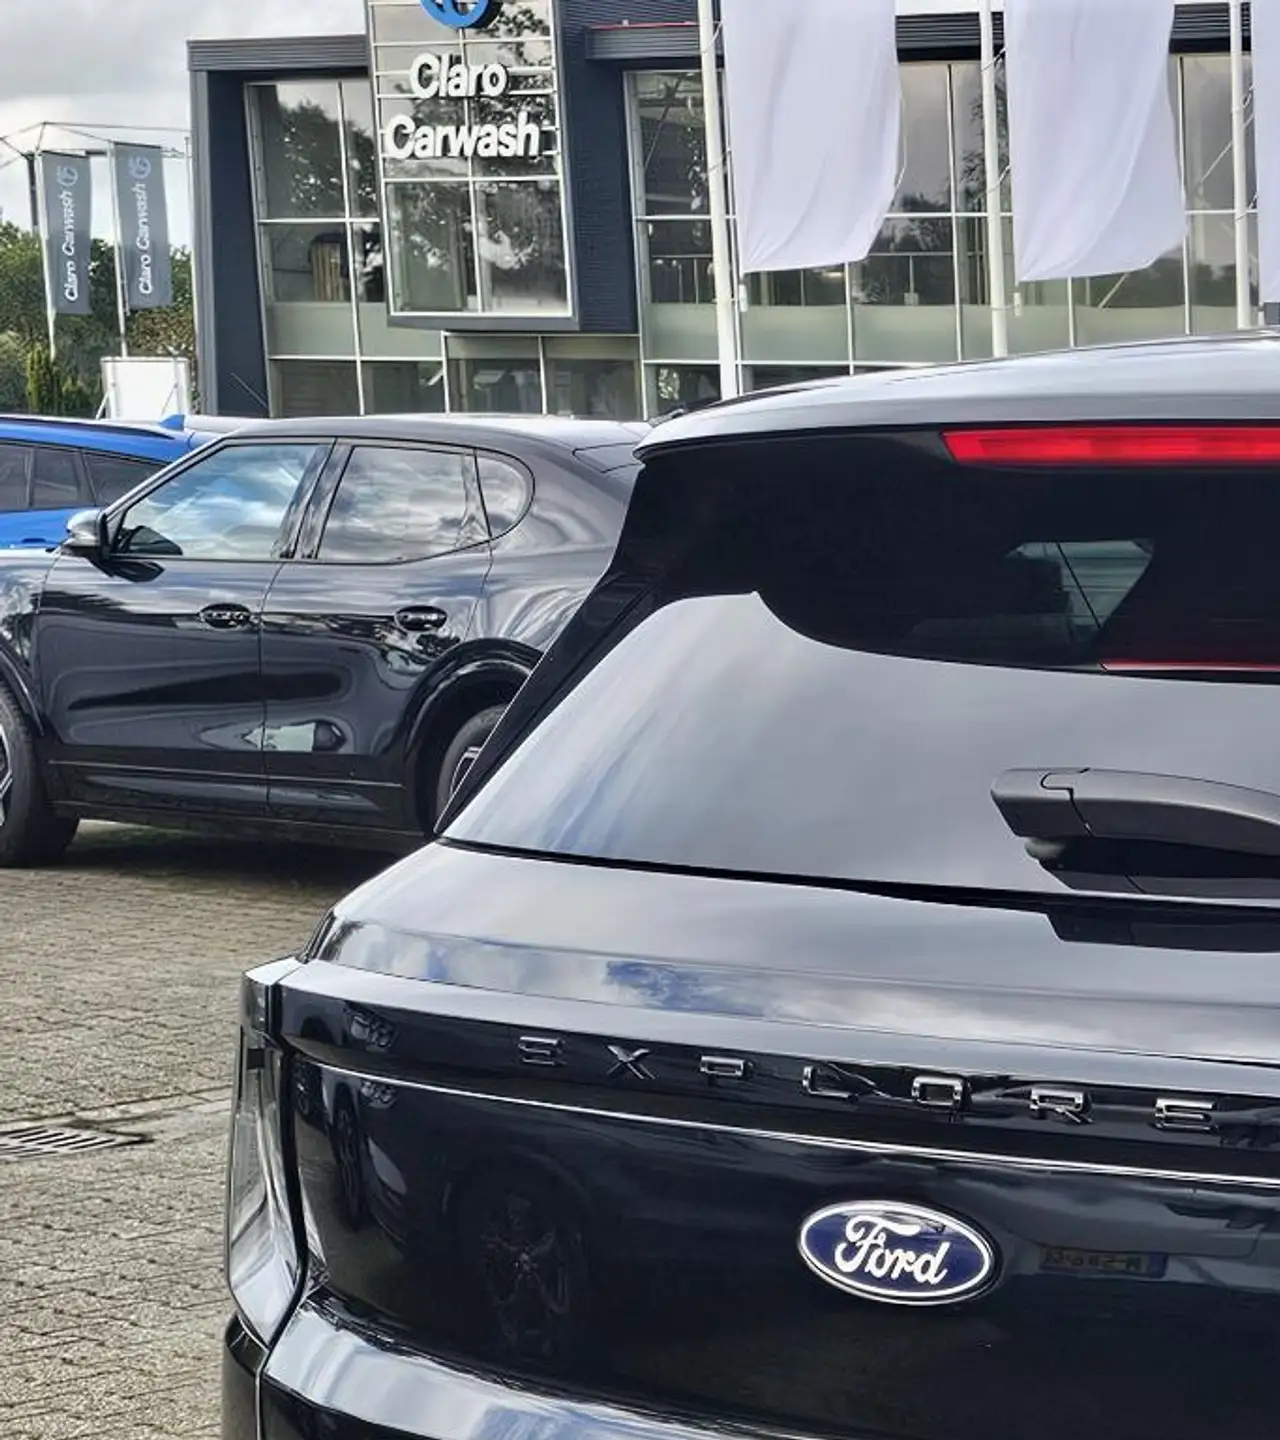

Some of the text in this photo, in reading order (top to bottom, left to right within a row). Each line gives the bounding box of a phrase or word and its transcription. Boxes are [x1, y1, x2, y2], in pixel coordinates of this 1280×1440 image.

[410, 53, 508, 98] Claro
[385, 111, 540, 159] Carwash
[59, 190, 78, 301] Claro Carwash
[131, 183, 153, 294] Claro Carwash
[834, 1215, 950, 1285] Ford
